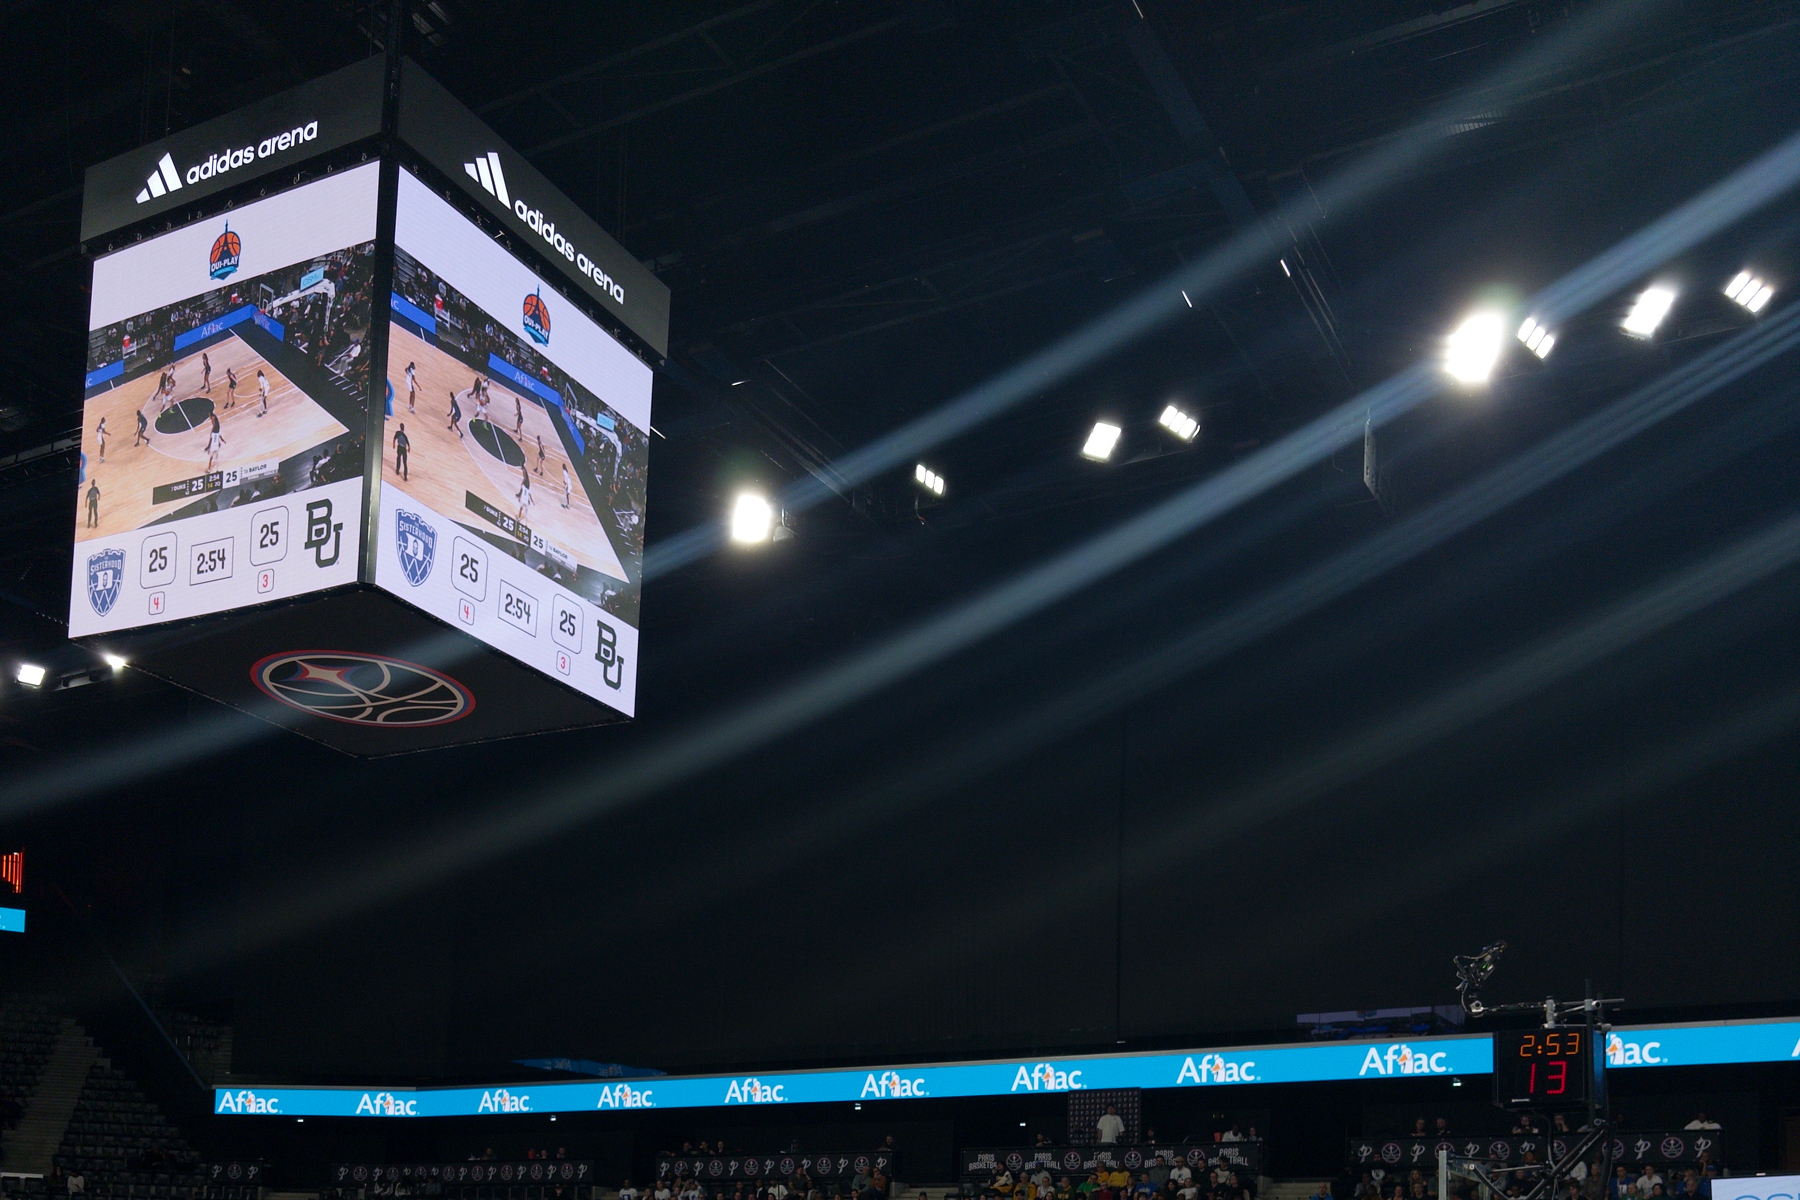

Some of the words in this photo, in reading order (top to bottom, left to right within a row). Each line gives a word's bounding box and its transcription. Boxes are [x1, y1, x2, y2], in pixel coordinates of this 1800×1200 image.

[186, 146, 255, 185] adidas
[258, 121, 319, 159] arena
[210, 255, 239, 273] OUI-PLAY
[514, 200, 575, 262] adidas
[577, 253, 625, 305] arena
[514, 372, 535, 391] Aflac
[174, 484, 187, 492] DUKE
[191, 479, 204, 492] 25
[208, 474, 220, 482] 2:54
[226, 471, 238, 484] 25
[248, 464, 267, 473] BAYLOR
[399, 520, 433, 549] SISTERHOOD
[502, 516, 515, 532] 25
[533, 535, 544, 549] 25
[149, 546, 168, 573] 25
[196, 548, 226, 575] 2:54
[259, 521, 280, 549] 25
[90, 559, 122, 575] SISTERHOOD
[262, 574, 269, 588] 3
[153, 597, 160, 610] 4
[460, 553, 479, 583] 25
[504, 592, 531, 625] 2:54
[559, 609, 576, 637] 25
[463, 605, 470, 619] 4
[560, 656, 567, 670] 3
[1520, 1032, 1581, 1057] 2:53
[1606, 1033, 1661, 1065] lac
[1176, 1054, 1256, 1084] Aflac
[1358, 1044, 1447, 1076] Aflac
[860, 1071, 925, 1098] Aflac
[1011, 1063, 1082, 1091] Aflac
[1529, 1060, 1567, 1094] 13
[217, 1091, 279, 1114] Aflac
[478, 1089, 530, 1112] Aflac
[597, 1084, 653, 1108] Aflac
[724, 1078, 784, 1104] Aflac
[355, 1092, 417, 1116] Aflac
[977, 1153, 995, 1162] PARIS
[1034, 1152, 1053, 1161] PARIS
[1218, 1147, 1239, 1157] PARIS
[968, 1161, 997, 1171] BASKETBA
[1024, 1160, 1062, 1170] BASTBALL
